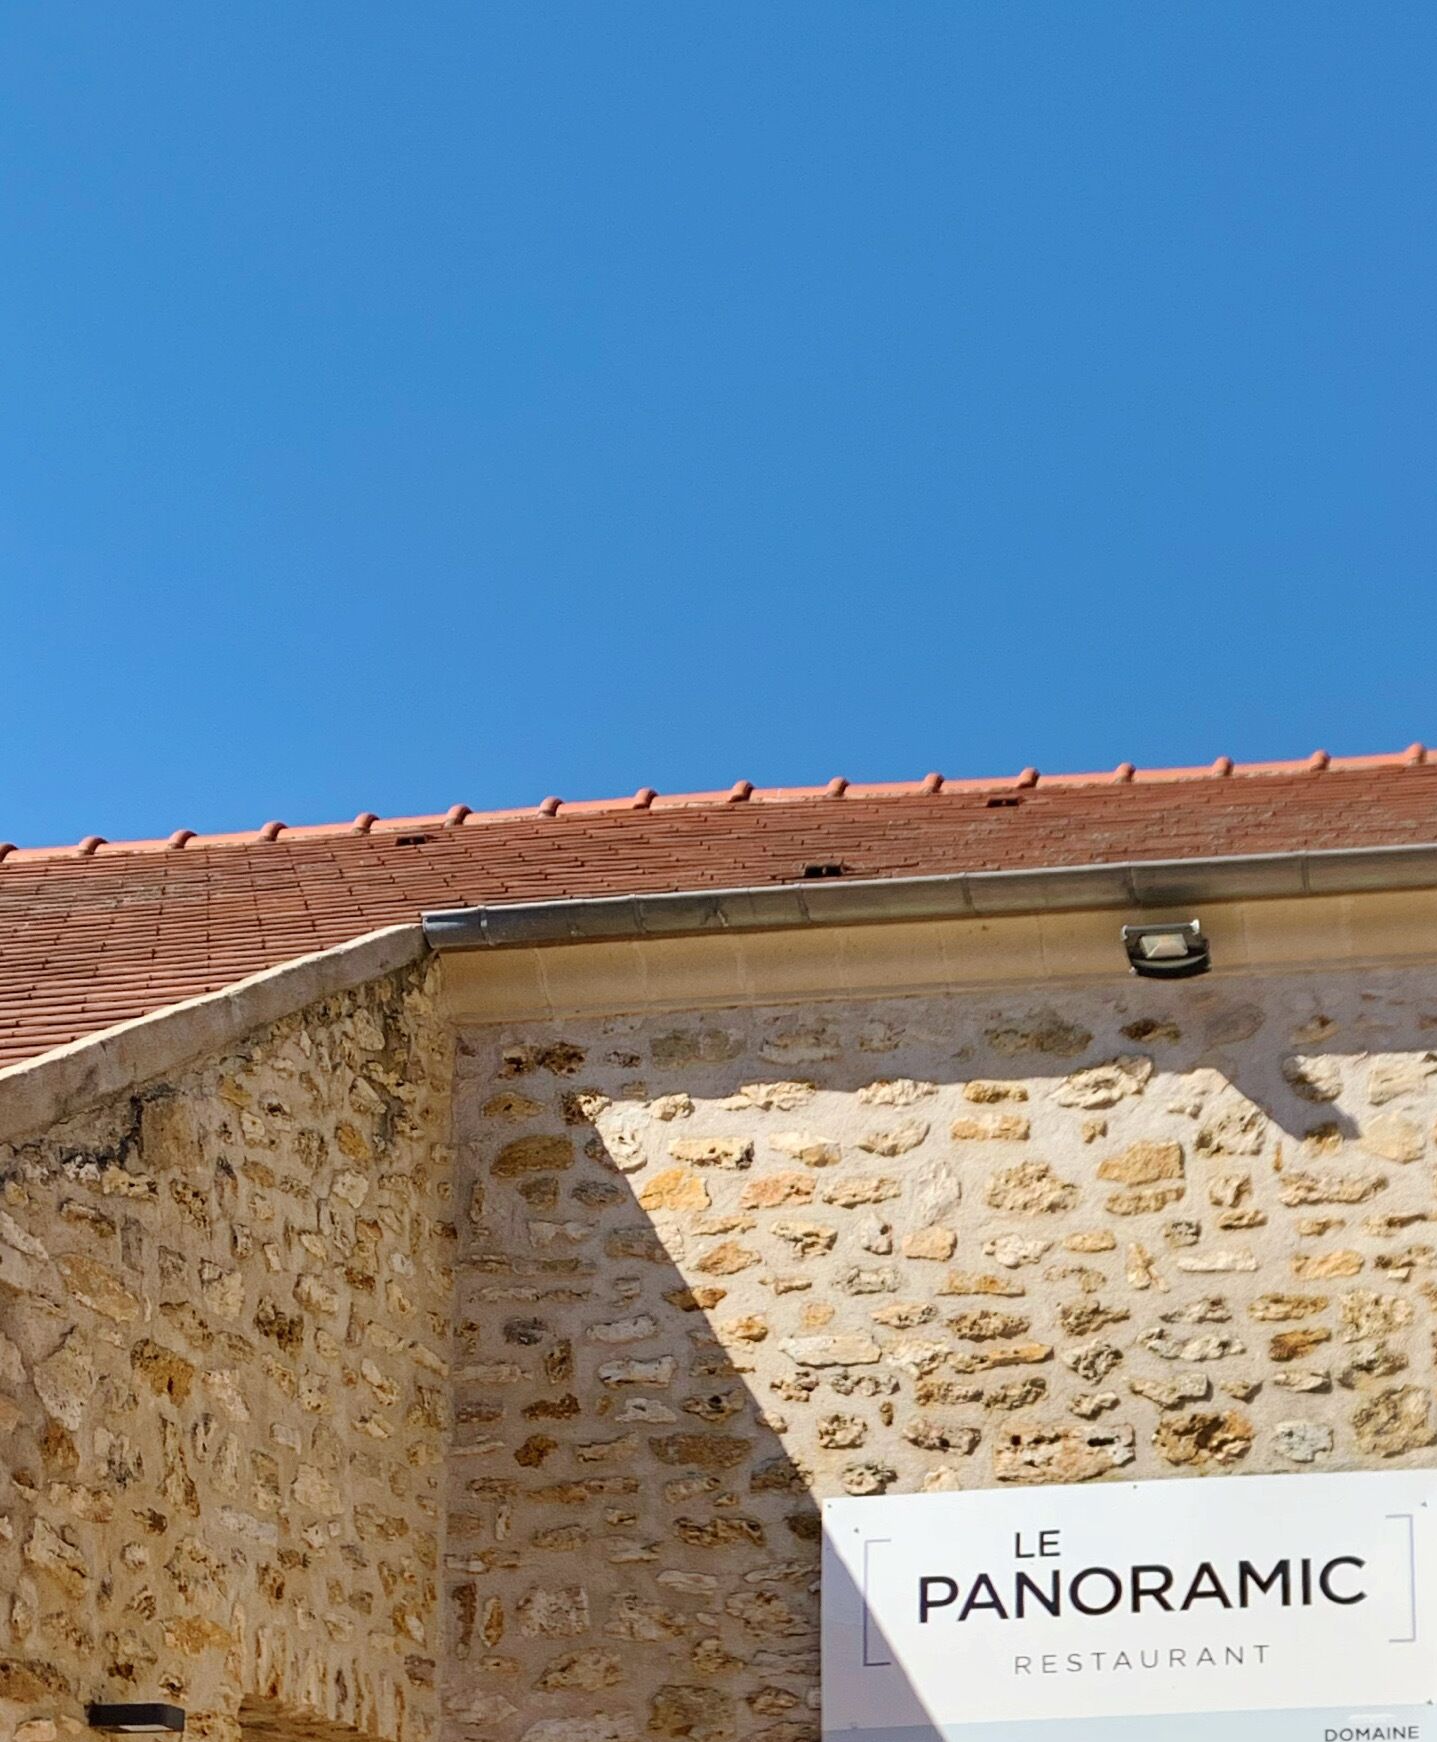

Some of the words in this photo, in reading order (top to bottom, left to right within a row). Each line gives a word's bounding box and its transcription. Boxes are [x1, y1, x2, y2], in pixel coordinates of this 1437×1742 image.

[1014, 1529, 1062, 1559] LE
[918, 1555, 1368, 1624] PANORAMIC
[1014, 1644, 1271, 1676] RESTAURANT
[1324, 1726, 1420, 1742] DOMAINE
